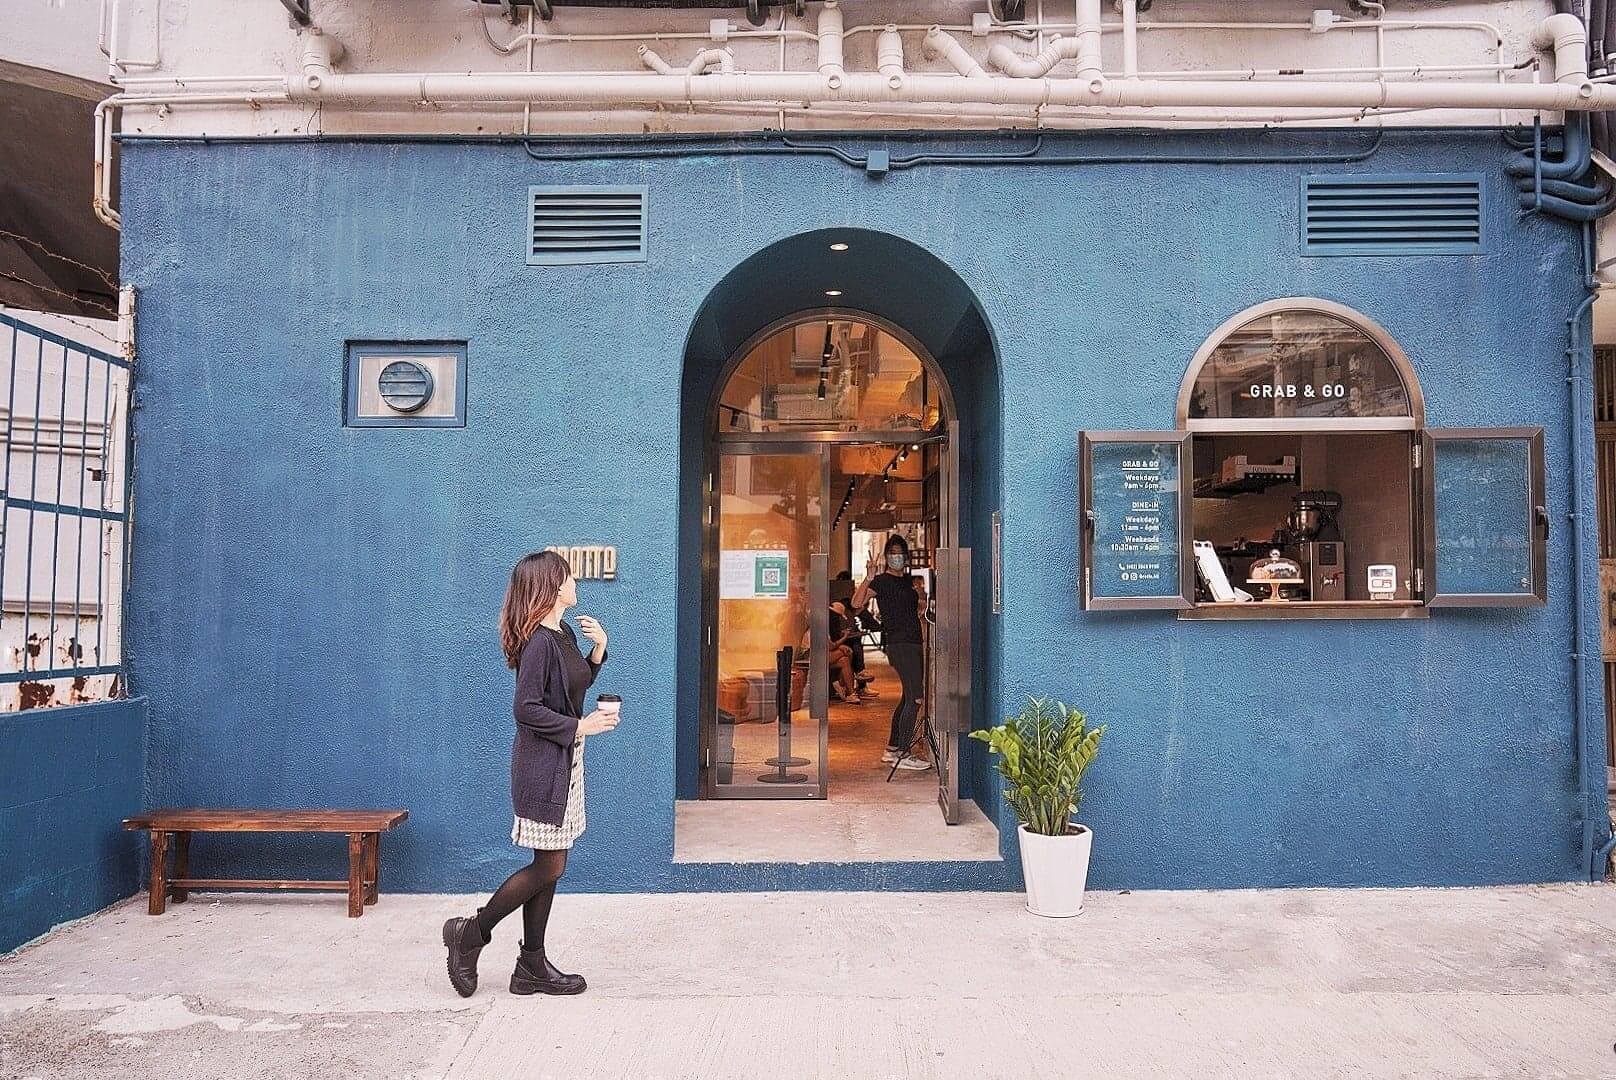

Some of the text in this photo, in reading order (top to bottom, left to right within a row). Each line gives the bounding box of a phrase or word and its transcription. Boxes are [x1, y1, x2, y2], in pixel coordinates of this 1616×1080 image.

[1250, 384, 1345, 398] GRAB & GO
[1125, 474, 1159, 482] Weekdays
[1144, 482, 1159, 490] 6pm
[1132, 501, 1159, 509] DINE-IN
[1125, 516, 1159, 524] Weekdays
